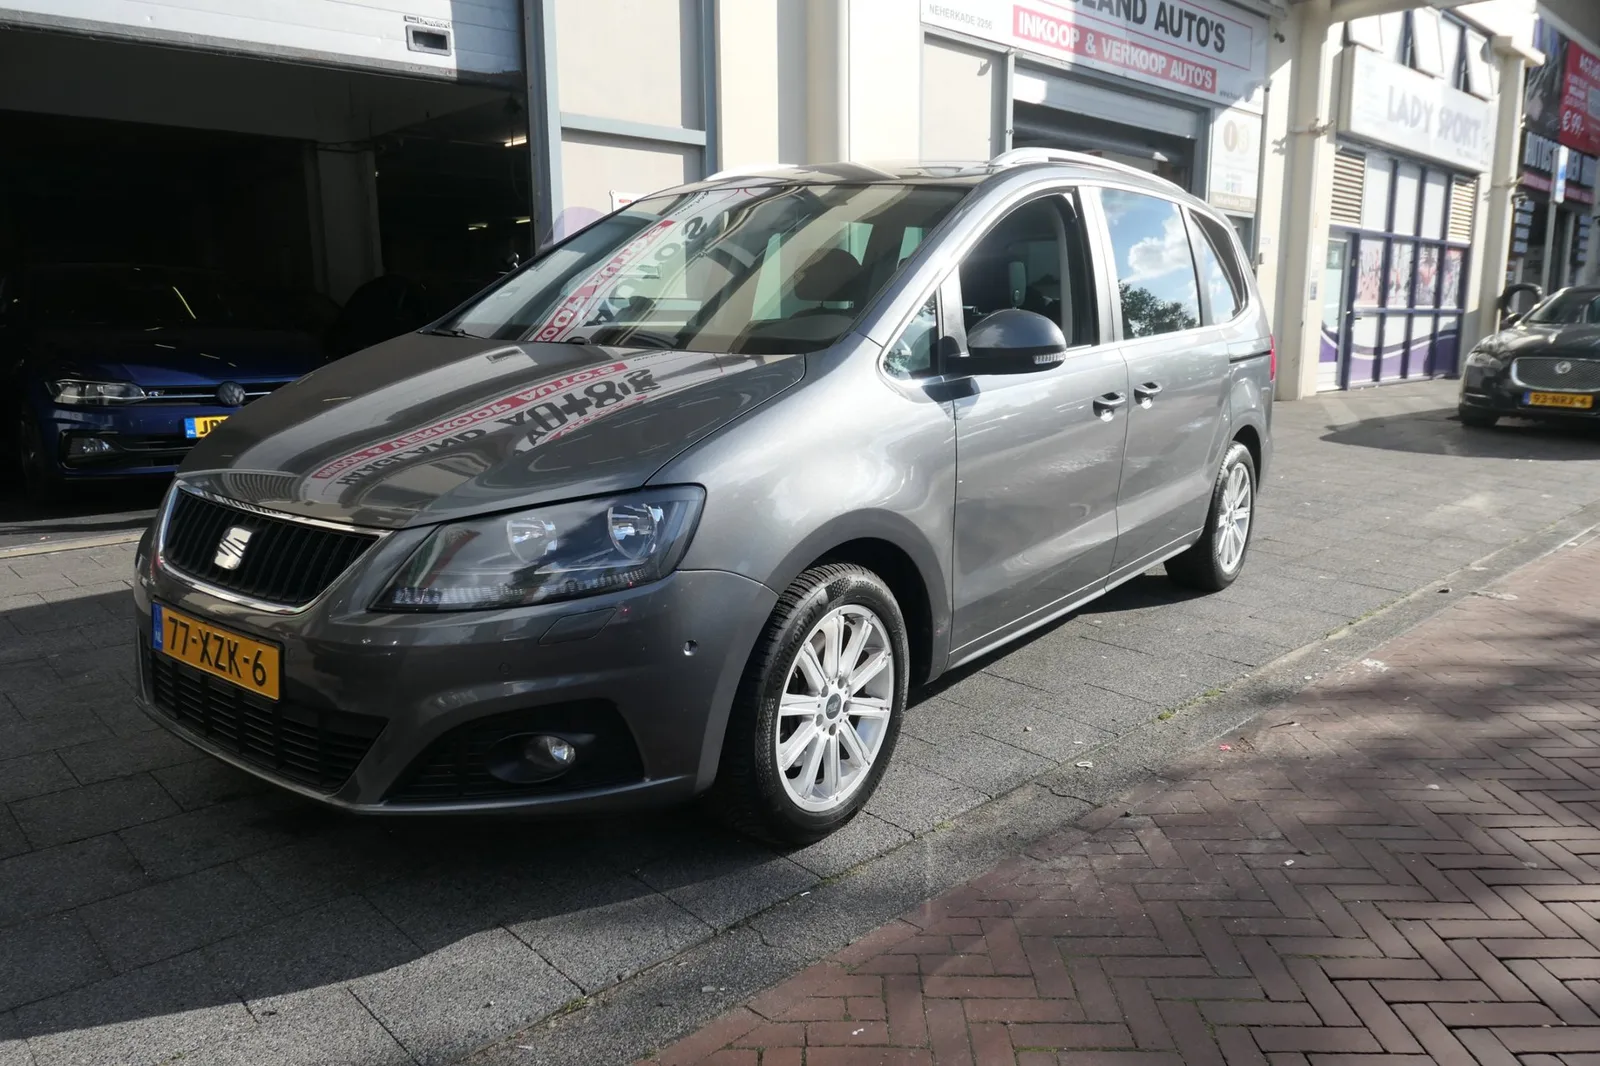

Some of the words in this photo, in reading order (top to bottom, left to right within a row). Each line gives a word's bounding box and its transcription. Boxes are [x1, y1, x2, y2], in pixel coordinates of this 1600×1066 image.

[929, 3, 976, 26] NEHERKADE
[1154, 2, 1226, 53] AUTO'S
[1019, 11, 1080, 49] INKOOP
[1085, 32, 1097, 54] &
[1102, 37, 1167, 75] VERKOOP
[1170, 60, 1213, 89] AUTO'S
[1387, 85, 1434, 134] LADY
[1438, 106, 1481, 149] SPORT
[168, 616, 267, 687] 77-XZK-6
